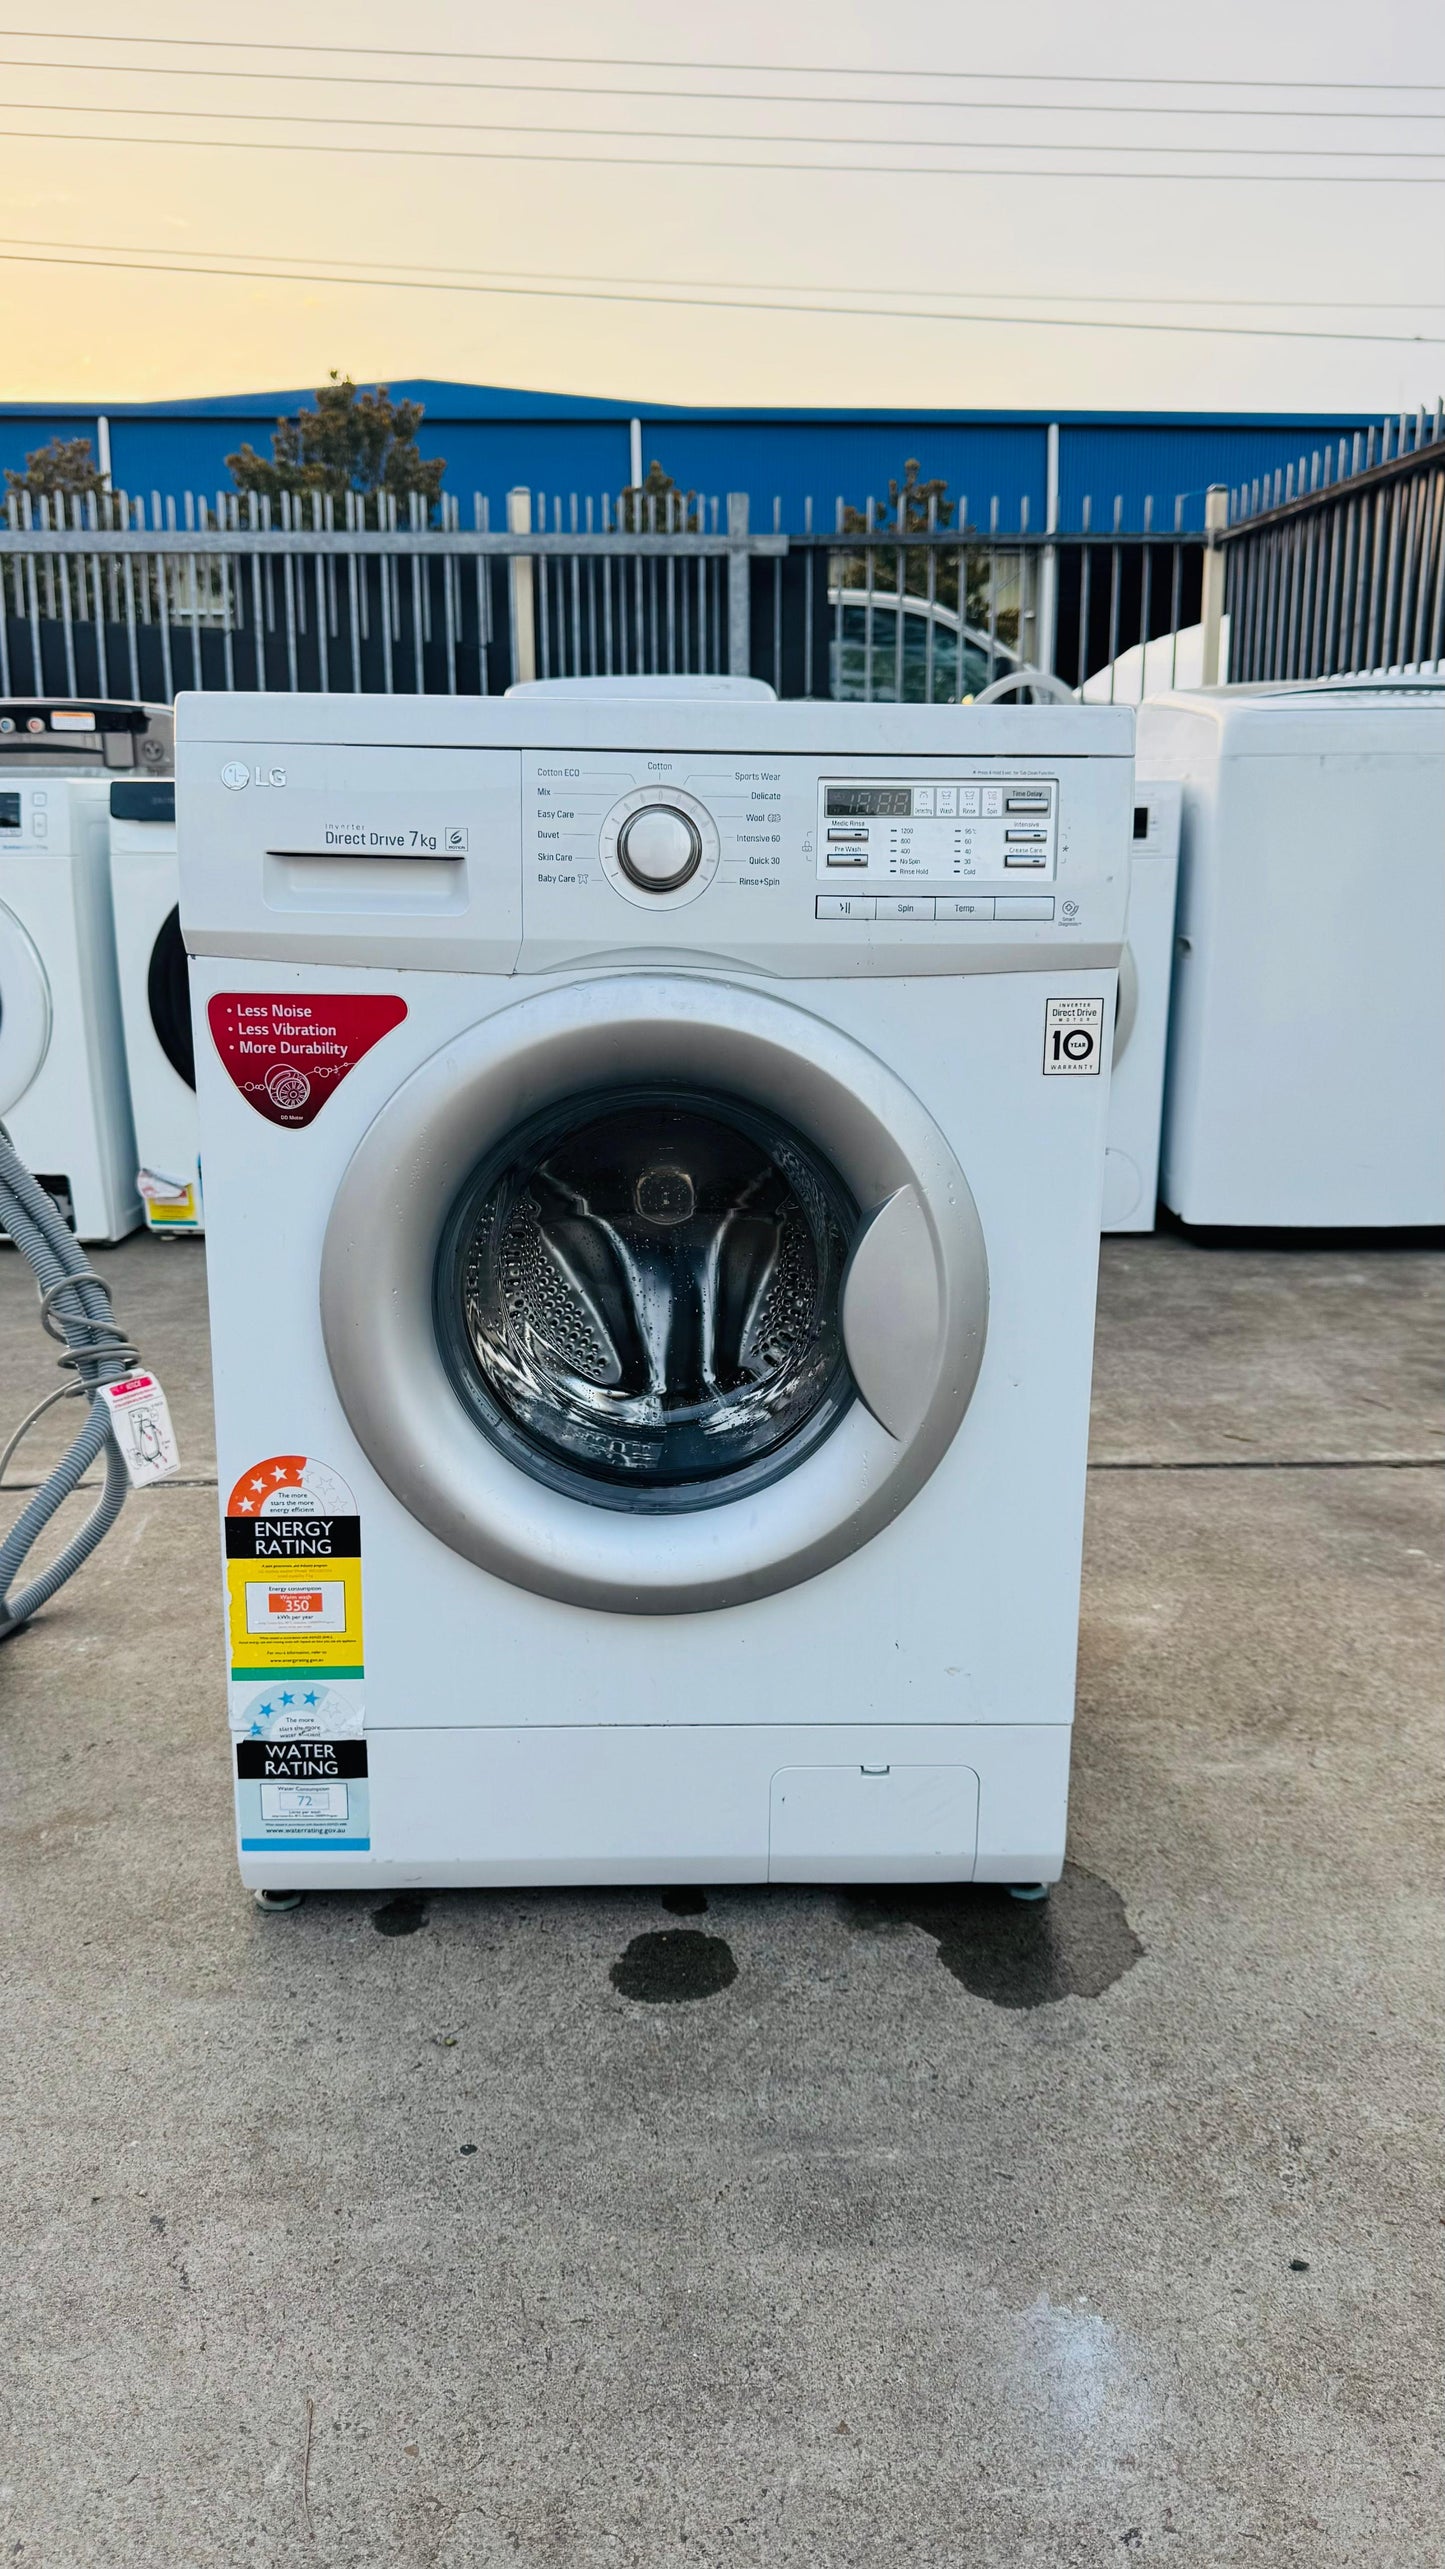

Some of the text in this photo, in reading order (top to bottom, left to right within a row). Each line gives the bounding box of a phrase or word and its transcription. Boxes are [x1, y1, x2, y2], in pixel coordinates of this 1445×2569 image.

[647, 761, 672, 770] Cotton
[255, 766, 287, 787] LG
[537, 768, 580, 777] Cotton ECO
[735, 772, 780, 782] Sports Wear
[537, 788, 551, 796] Mix
[751, 792, 781, 800] Delicate
[537, 810, 574, 820] Easy Care
[746, 814, 765, 822] Wool
[325, 832, 366, 845] Direct
[370, 833, 405, 846] Drive
[737, 834, 770, 842] Intensive
[538, 853, 554, 861] Skin
[749, 856, 769, 865] Quick
[538, 875, 576, 884] Baby Care
[739, 877, 780, 886] Rinse+Spin
[898, 904, 914, 913] Spin
[237, 1004, 312, 1017] Less Noise
[238, 1023, 337, 1036] Less Vibration
[240, 1042, 348, 1058] More Durability
[1053, 1030, 1093, 1060] 10
[254, 1521, 333, 1537] ENERGY
[255, 1540, 332, 1555] RATING
[285, 1600, 309, 1611] 350
[266, 1744, 336, 1759] WATER
[265, 1761, 338, 1775] RATING
[297, 1795, 312, 1806] 72
